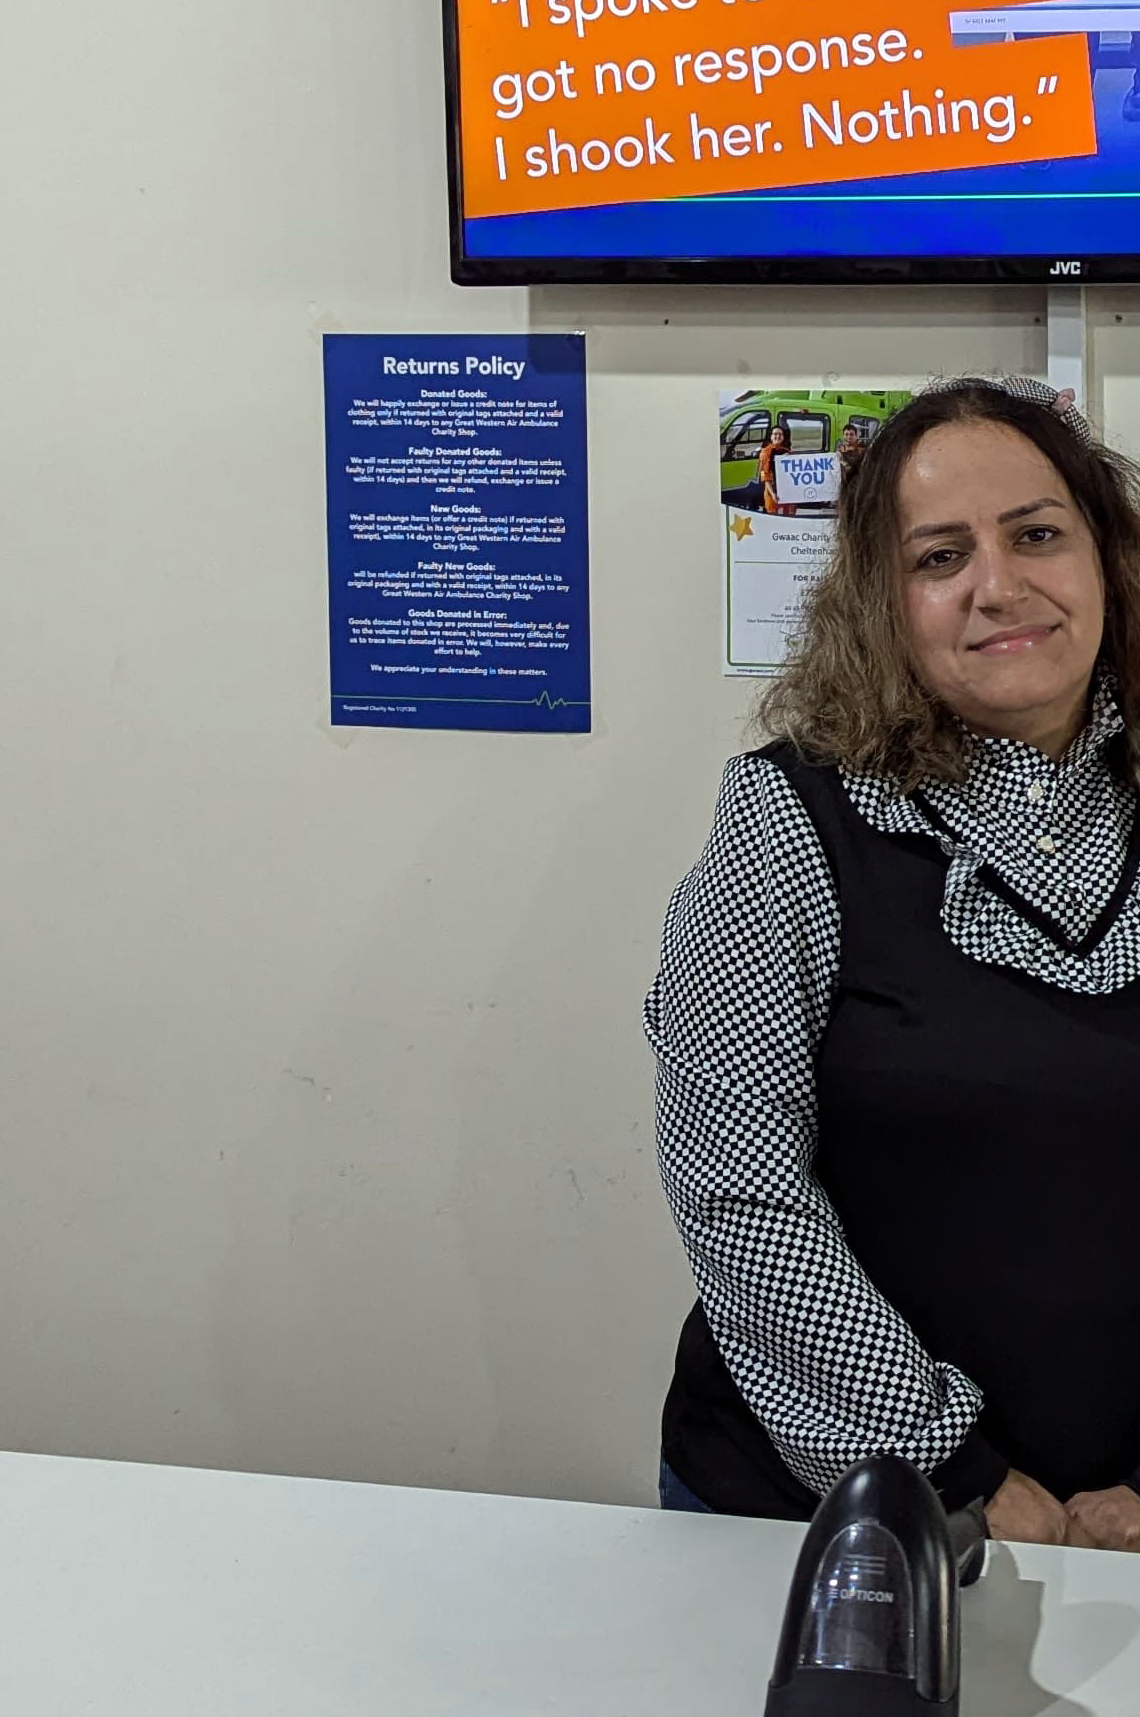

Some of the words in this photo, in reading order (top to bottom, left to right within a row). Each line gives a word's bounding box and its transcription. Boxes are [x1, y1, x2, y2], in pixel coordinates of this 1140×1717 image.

[492, 60, 578, 119] got
[594, 58, 656, 95] no
[674, 29, 923, 94] response.
[495, 136, 508, 180] I
[525, 117, 675, 178] shook
[690, 113, 783, 159] her.
[1050, 261, 1081, 275] JVC
[383, 356, 459, 374] Returns
[465, 356, 524, 380] Policy
[420, 389, 456, 398] Donated
[457, 389, 487, 398] Goods:
[408, 446, 434, 456] Faulty
[435, 446, 471, 456] Donated
[472, 447, 502, 456] Goods:
[781, 457, 835, 473] THANK
[790, 471, 825, 486] YOU
[430, 504, 450, 513] New
[451, 504, 481, 513] Goods:
[772, 532, 799, 541] Gwaac
[417, 561, 443, 570] Faulty
[444, 561, 464, 570] New
[466, 562, 495, 571] Goods:
[407, 608, 435, 618] Goods
[436, 609, 472, 618] Donated
[473, 610, 481, 618] in
[482, 610, 507, 619] Error:
[840, 1588, 894, 1603] OPTICON
